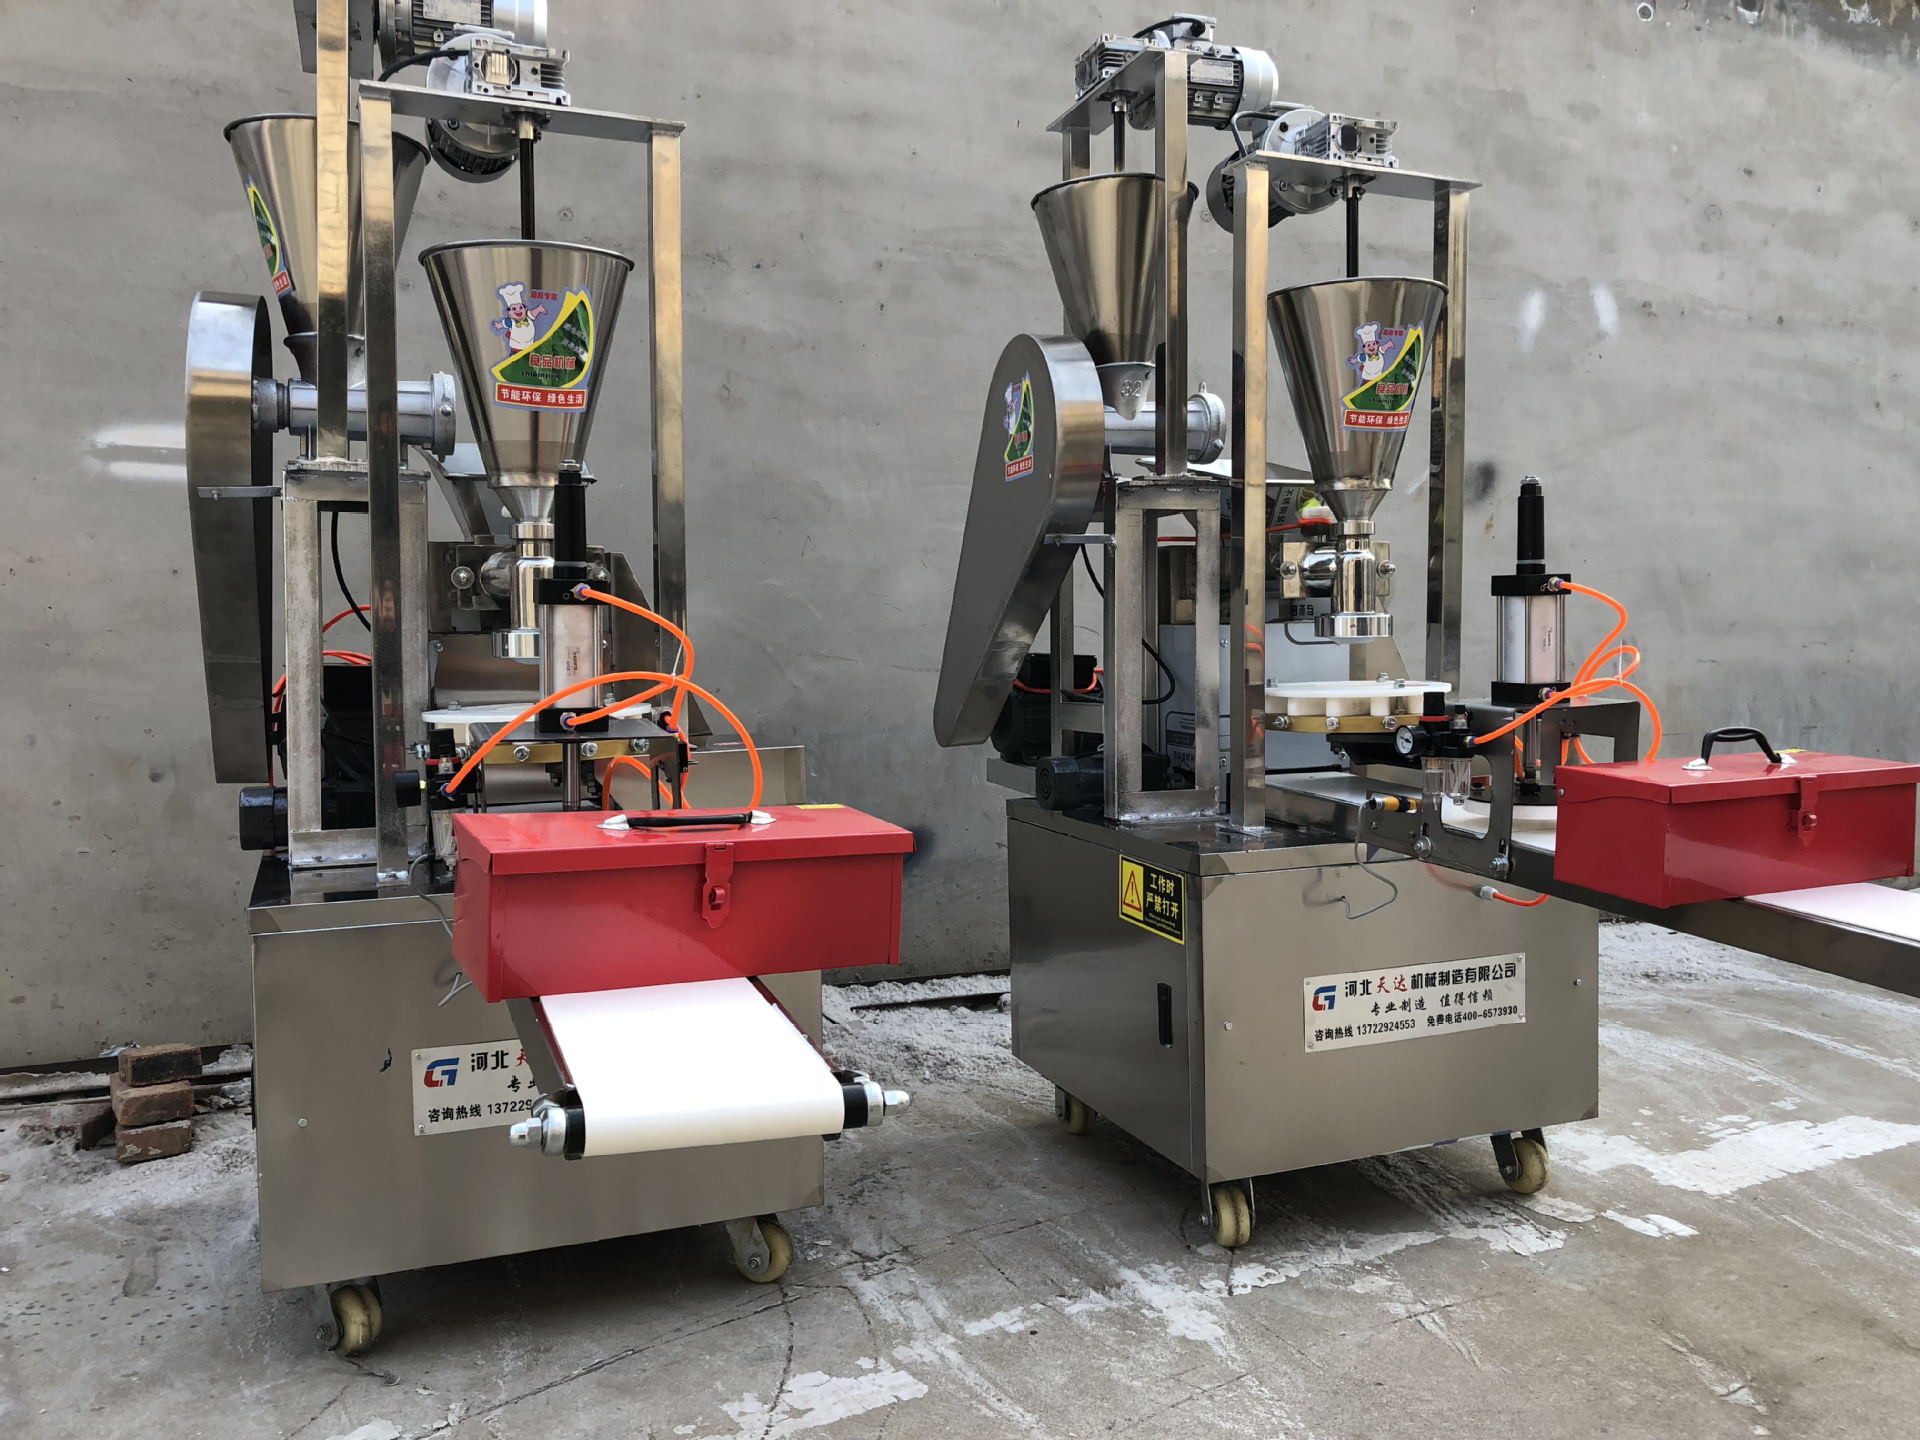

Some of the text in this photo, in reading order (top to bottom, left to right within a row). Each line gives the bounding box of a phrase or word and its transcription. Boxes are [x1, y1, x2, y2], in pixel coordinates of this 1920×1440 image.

[500, 387, 584, 404] 节能环保 绿色生活
[1121, 379, 1143, 397] 32
[1349, 413, 1384, 425] 节能环保
[1150, 873, 1175, 897] 工作时
[1145, 891, 1179, 920] 严禁打开
[1344, 962, 1517, 998] 河北天达机械制造有限公司
[1370, 996, 1427, 1016] 专业制造
[1314, 1025, 1354, 1042] 咨询热线
[1356, 1018, 1416, 1036] 13722924553
[427, 1103, 482, 1123] 咨询热线
